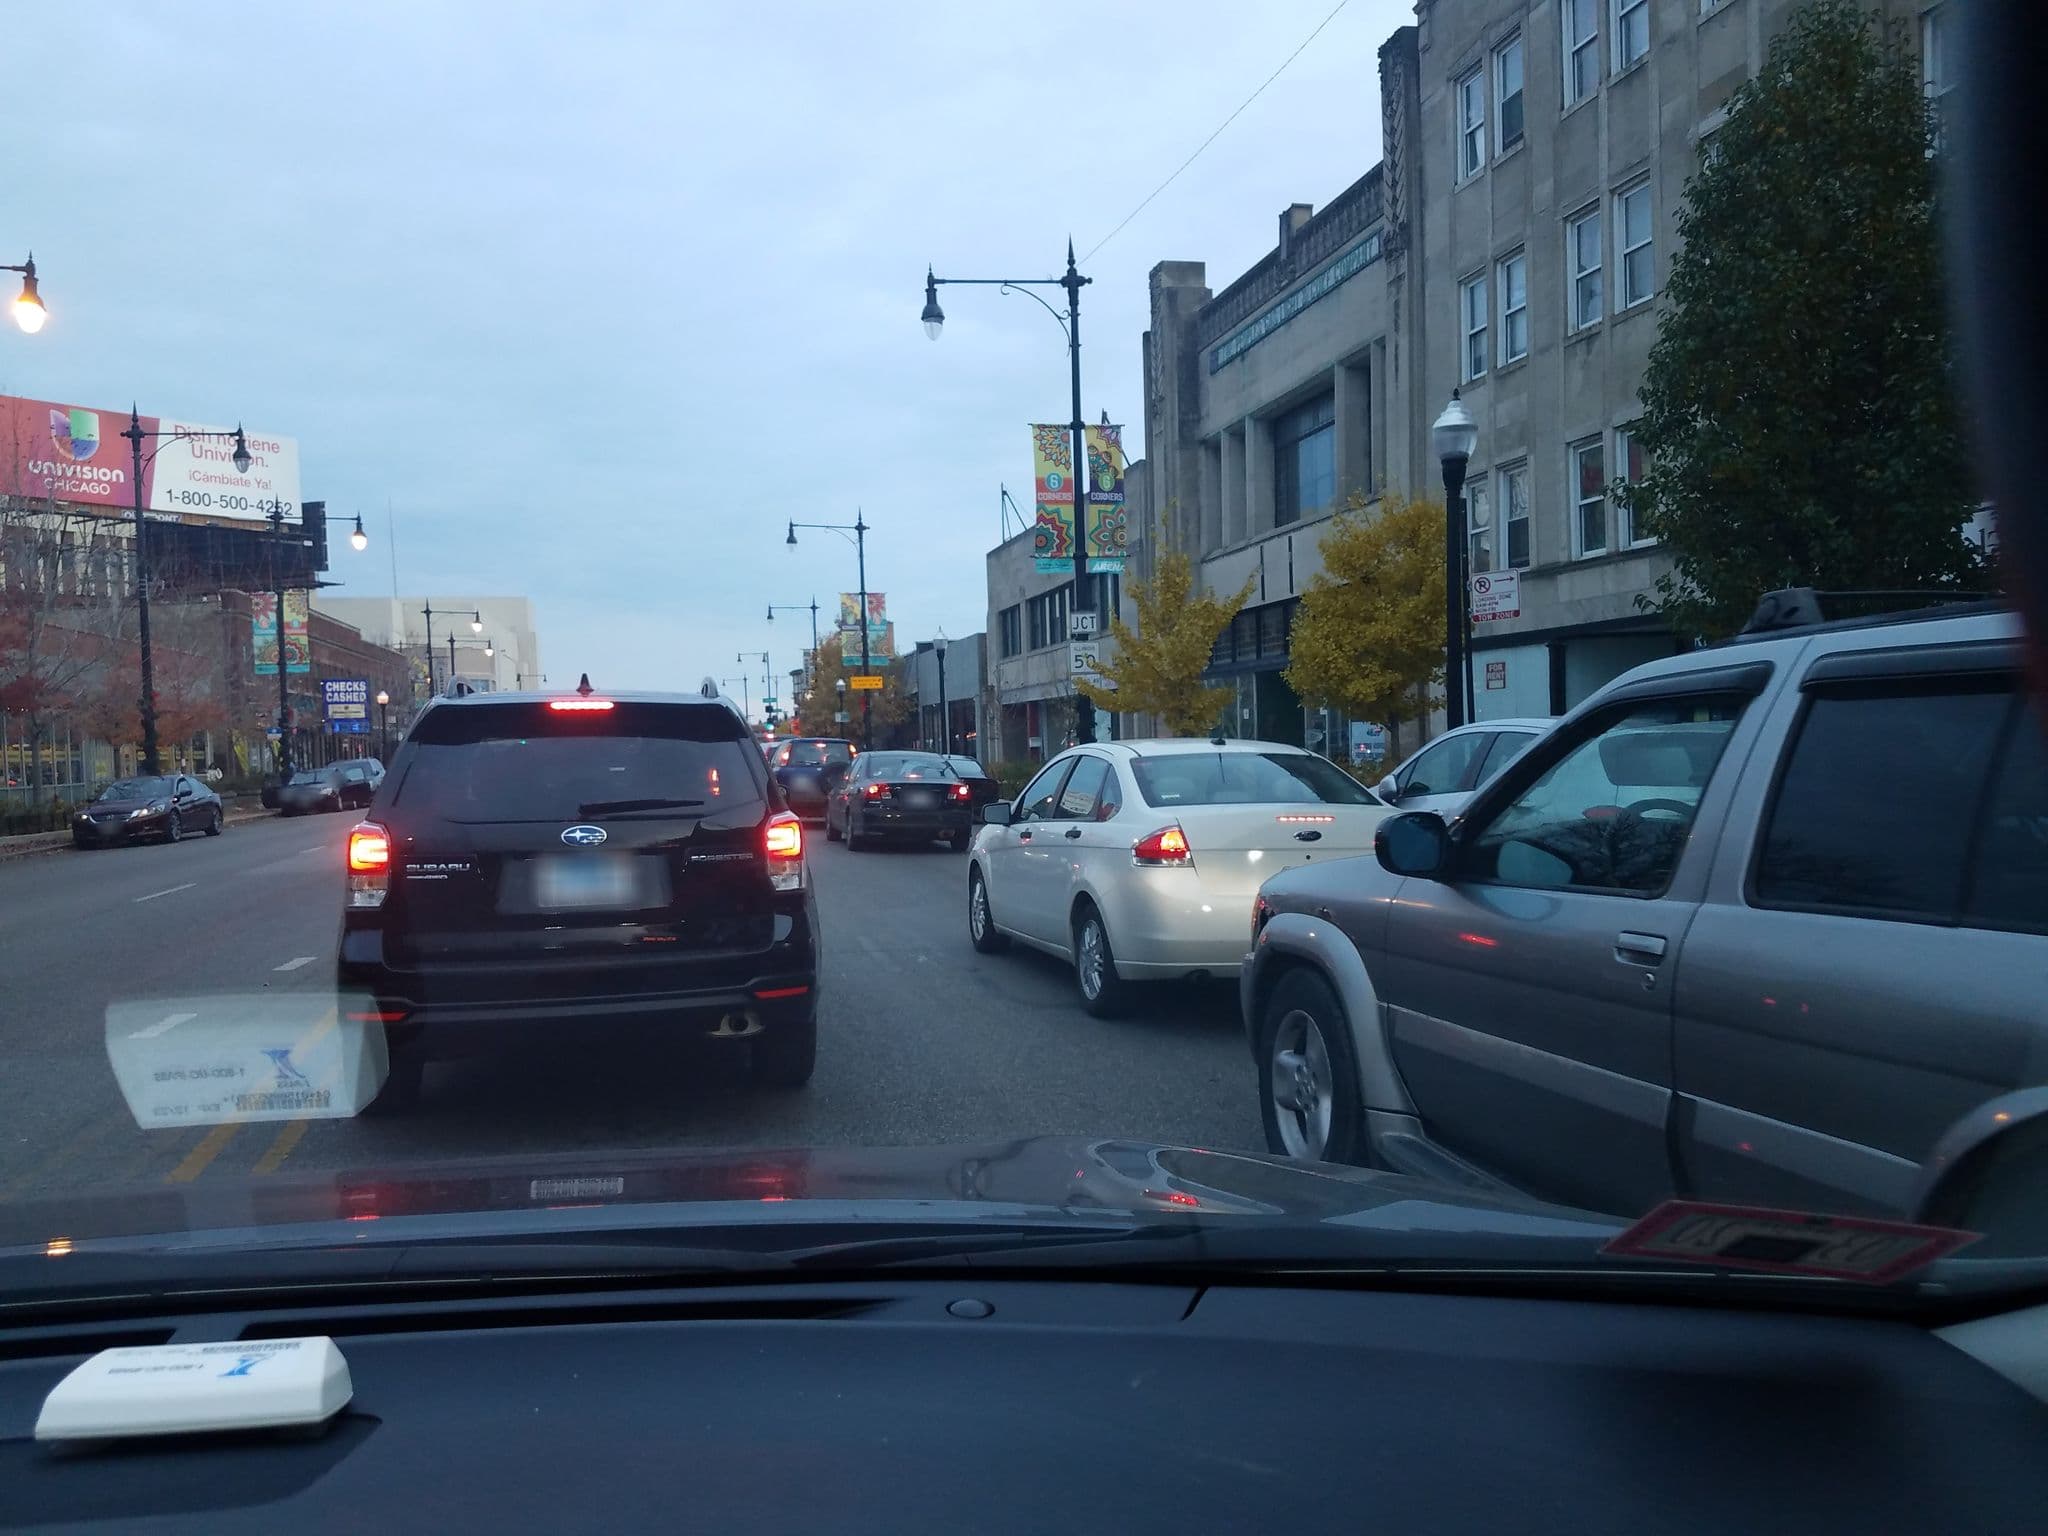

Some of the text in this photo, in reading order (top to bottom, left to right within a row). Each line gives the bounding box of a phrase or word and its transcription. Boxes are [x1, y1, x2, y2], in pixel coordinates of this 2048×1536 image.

[244, 434, 280, 455] iene
[44, 478, 111, 496] CHICAGO
[1051, 473, 1059, 490] 6
[1102, 474, 1111, 491] 6
[1091, 492, 1124, 501] CORNERS
[1073, 616, 1096, 630] JCT
[1488, 663, 1503, 672] FOR
[1487, 671, 1505, 681] RENT
[325, 681, 367, 692] CHECKS
[326, 692, 367, 703] CASHED
[406, 863, 471, 872] SUBARU
